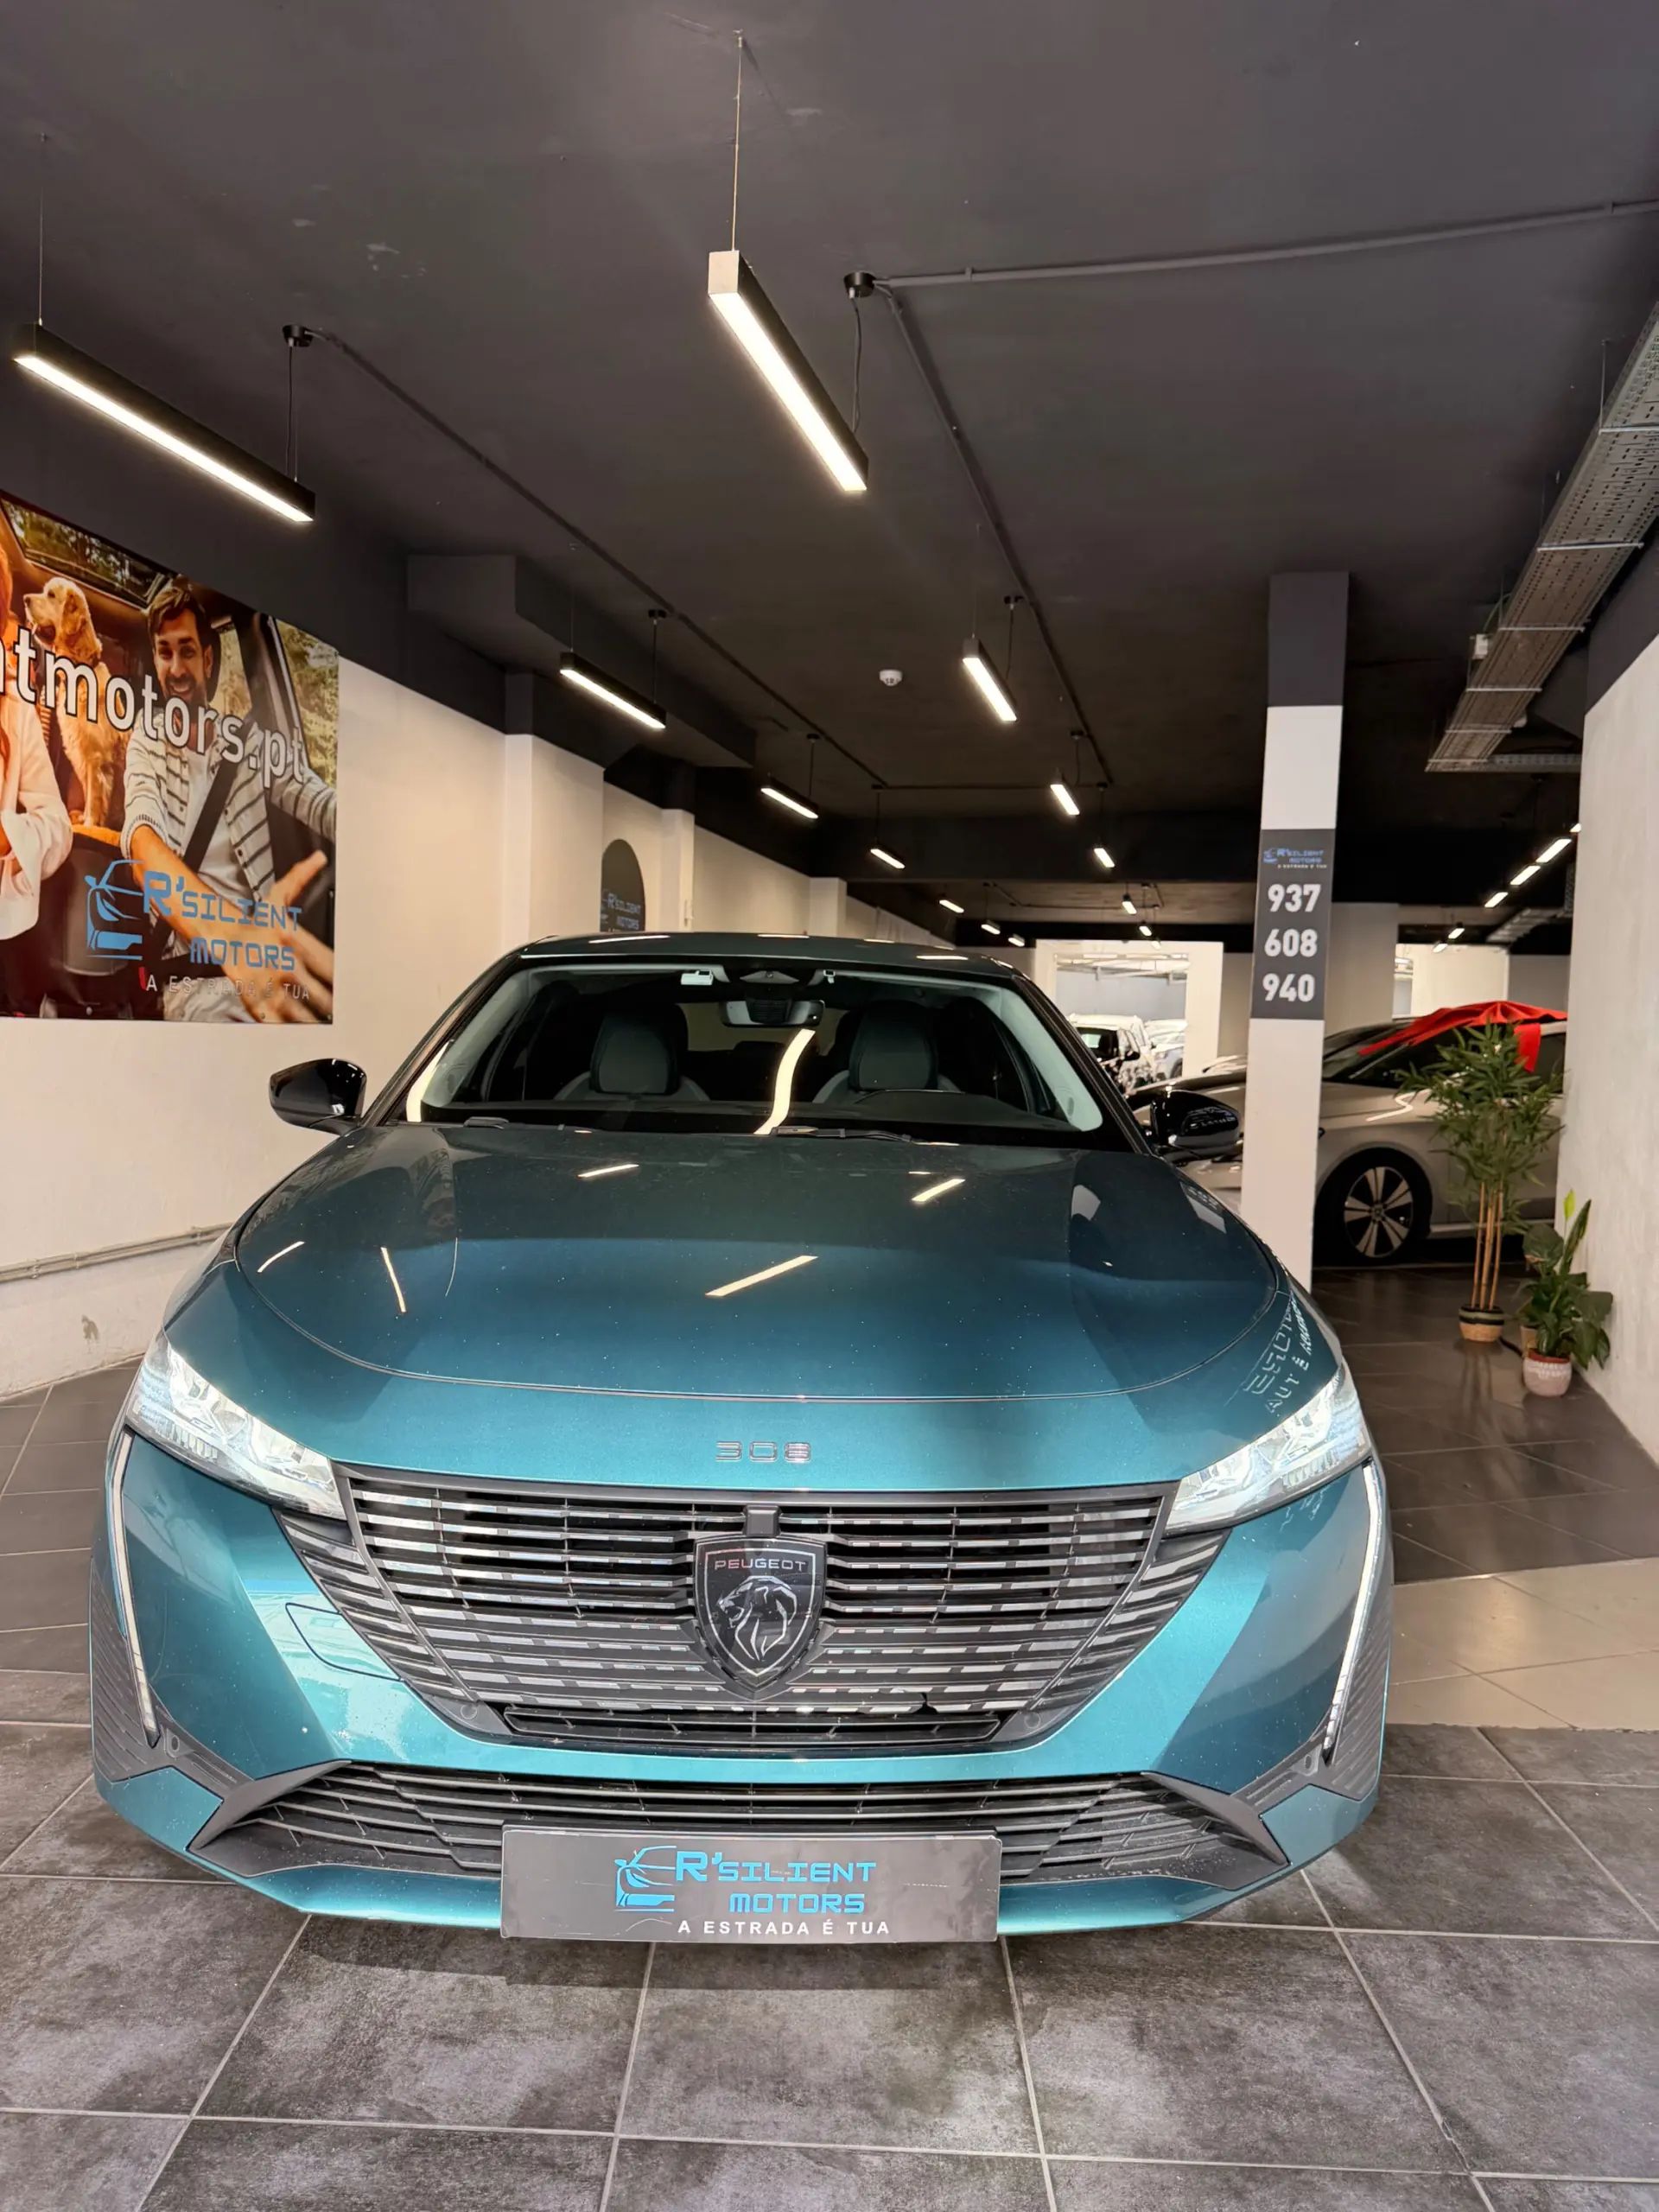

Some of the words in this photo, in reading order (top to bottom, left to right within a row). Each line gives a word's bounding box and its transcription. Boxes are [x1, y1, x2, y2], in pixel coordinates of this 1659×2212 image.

[143, 870, 302, 931] R'SILIENT
[1268, 884, 1321, 912] 937
[189, 937, 296, 971] MOTORS
[1264, 929, 1318, 957] 608
[283, 983, 309, 1000] TUA
[1262, 973, 1315, 1001] 940
[715, 1440, 811, 1463] 308
[715, 1558, 806, 1571] PEUGEOT
[676, 1851, 876, 1882] R'SILIENT
[729, 1893, 865, 1913] MOTORS
[677, 1920, 691, 1934] A
[703, 1920, 810, 1936] ESTRADA
[823, 1919, 833, 1935] É
[847, 1921, 889, 1935] TUA
